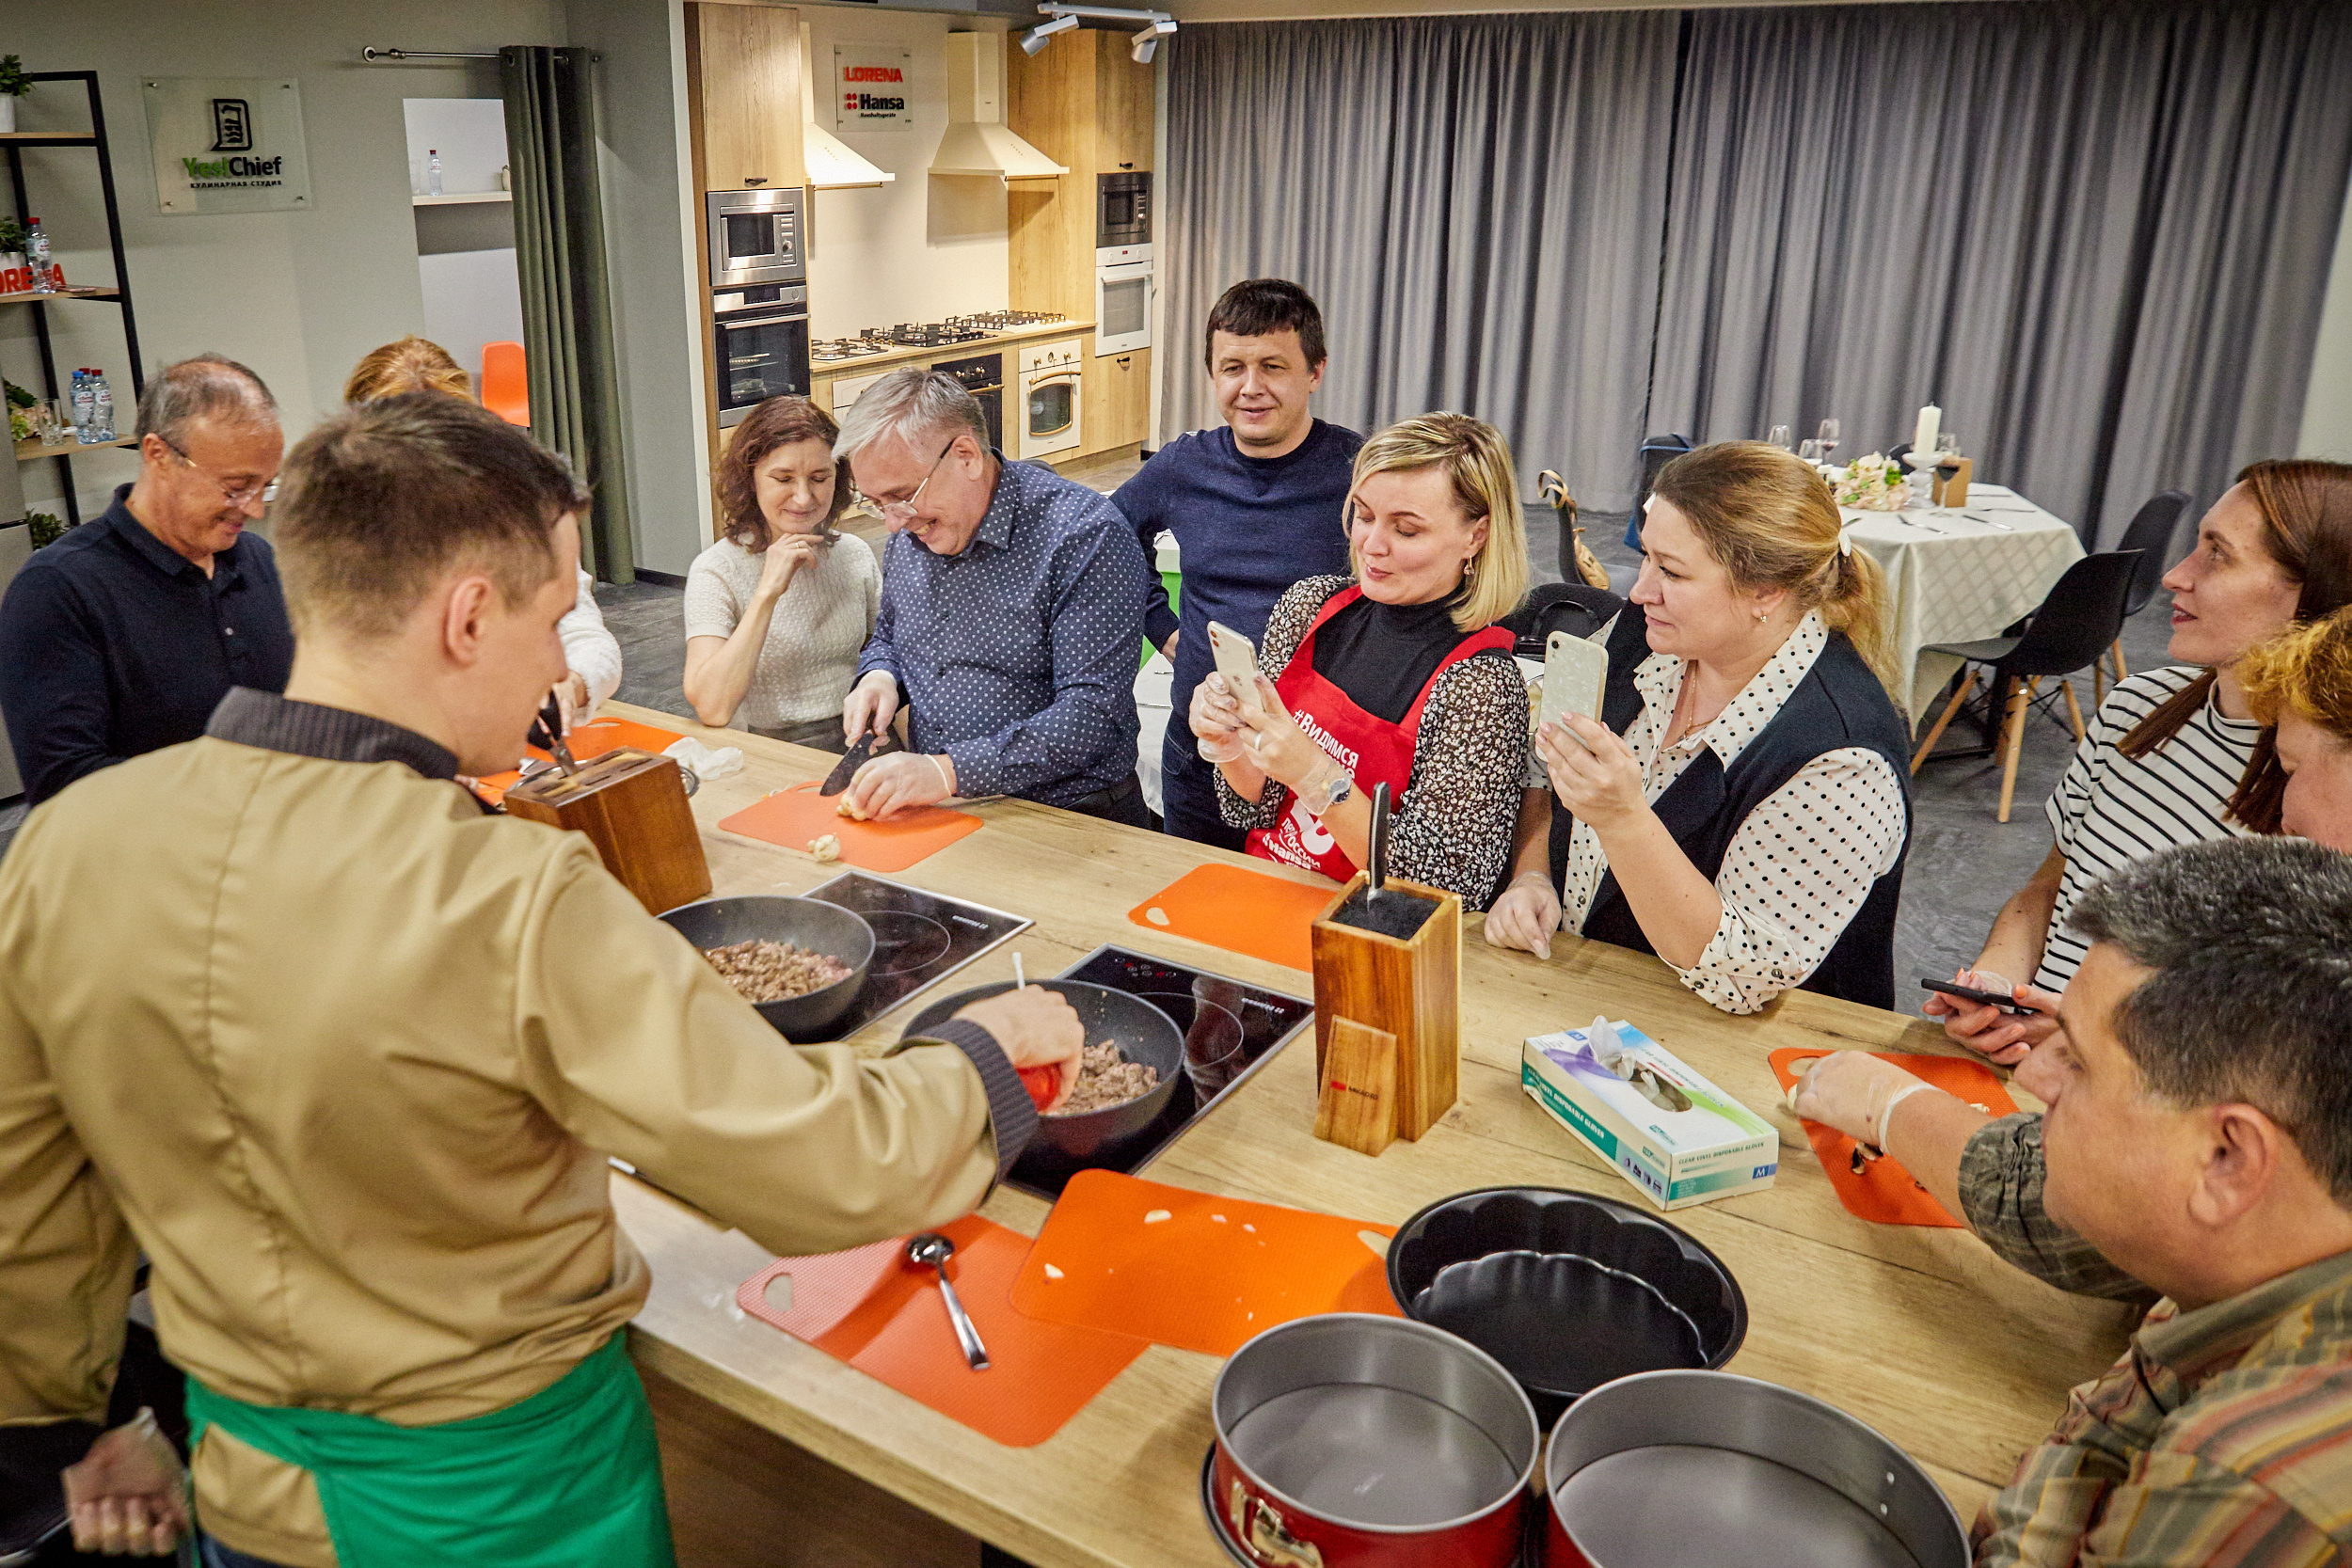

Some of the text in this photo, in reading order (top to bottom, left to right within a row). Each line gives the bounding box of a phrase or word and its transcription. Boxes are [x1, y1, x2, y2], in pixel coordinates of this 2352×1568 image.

[845, 66, 903, 83] LORENA
[860, 93, 904, 110] Hansa
[190, 181, 247, 189] КУЛИНАРНАЯ
[1268, 839, 1311, 870] Hansa
[1756, 1167, 1766, 1178] M
